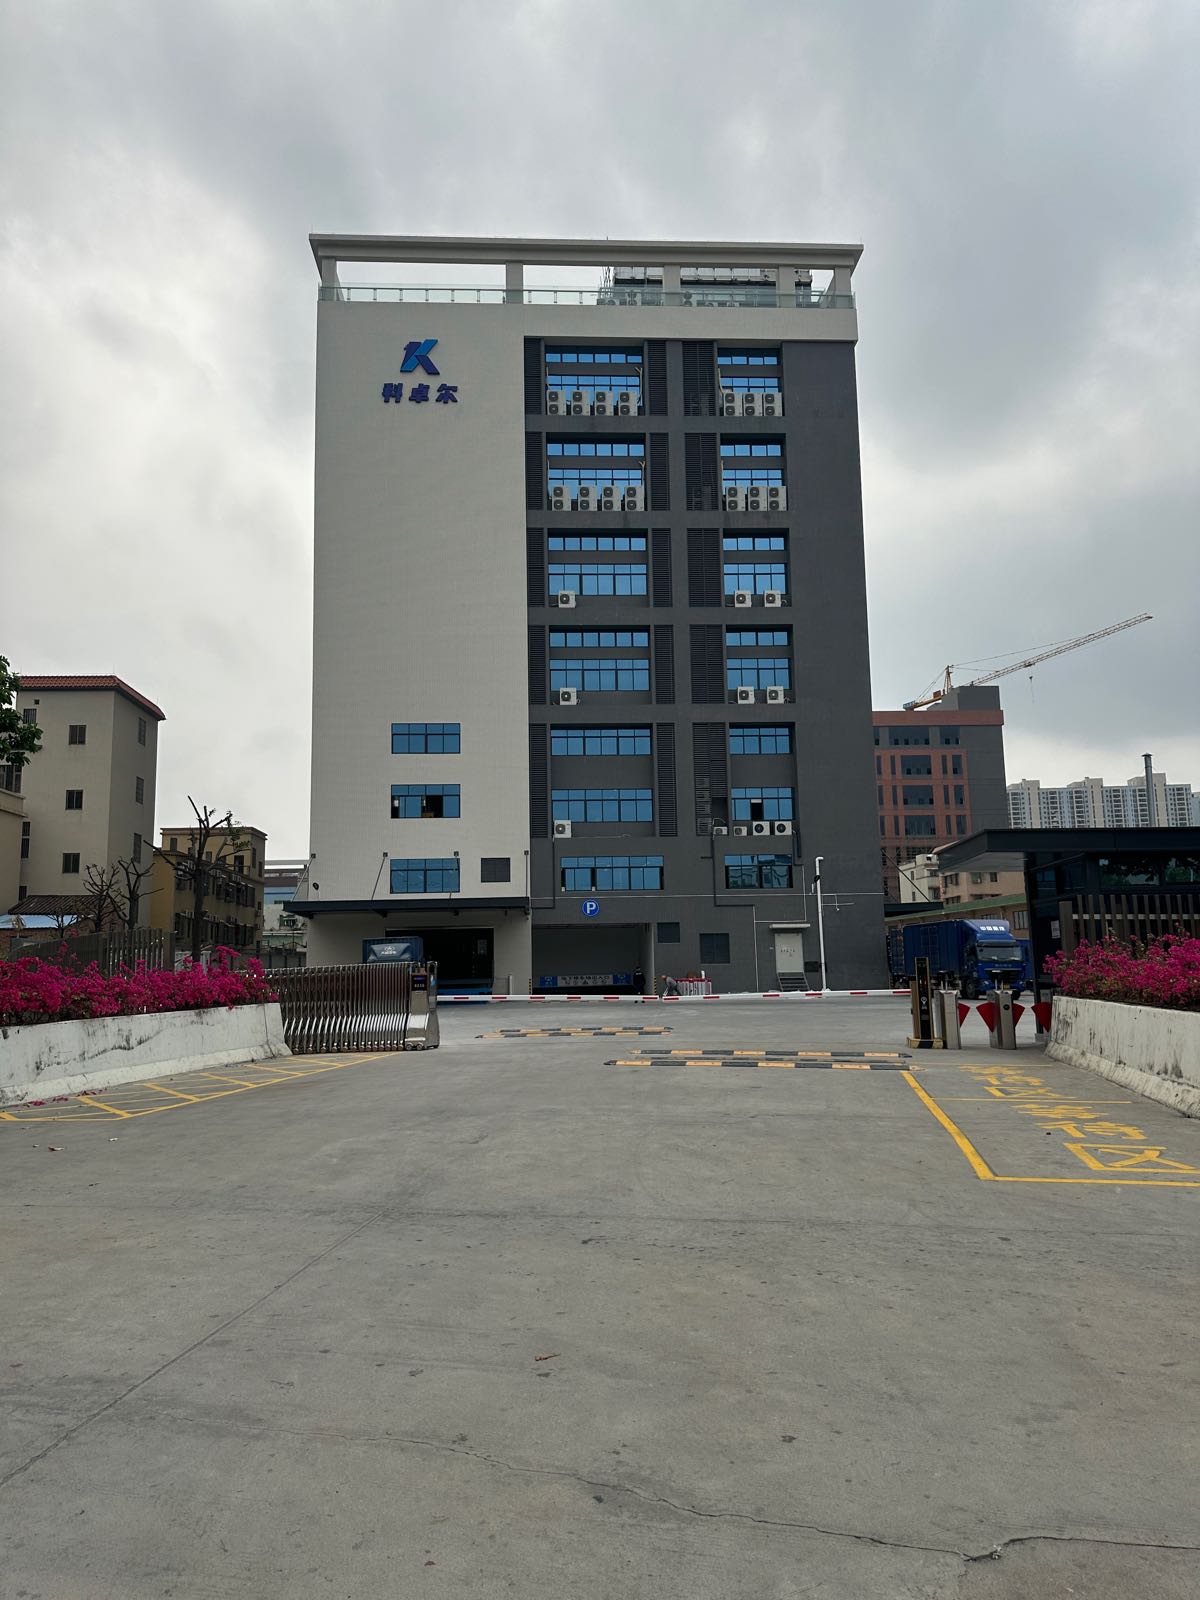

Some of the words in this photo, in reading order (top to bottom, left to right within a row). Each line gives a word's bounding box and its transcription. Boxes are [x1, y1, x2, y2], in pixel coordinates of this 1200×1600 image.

[382, 383, 458, 404] 科卓尔
[586, 901, 597, 914] P
